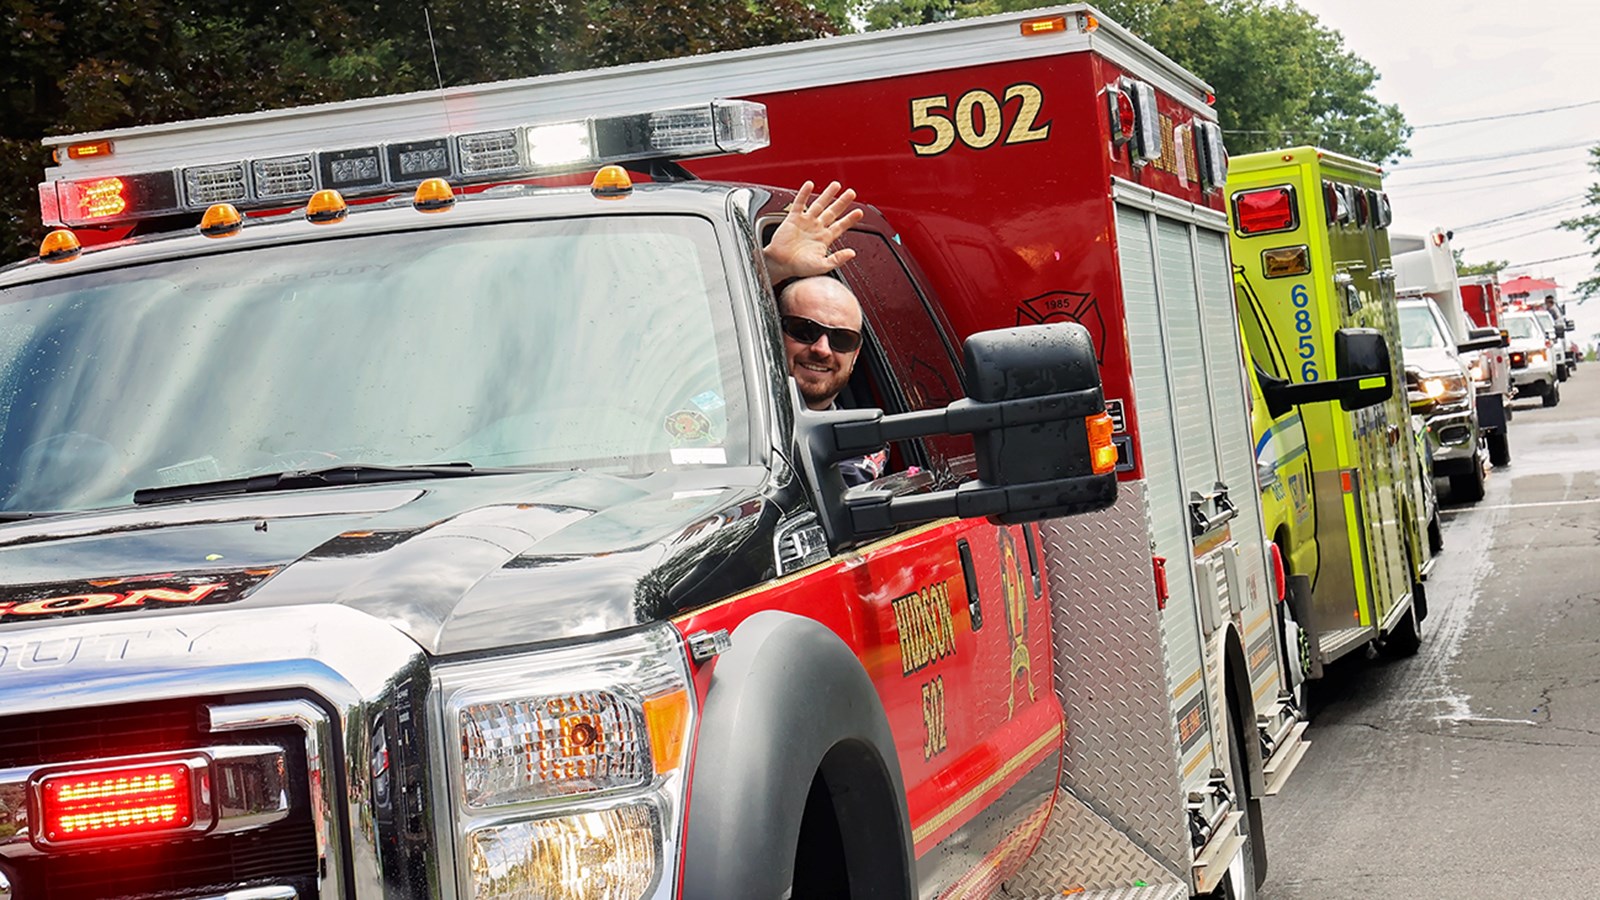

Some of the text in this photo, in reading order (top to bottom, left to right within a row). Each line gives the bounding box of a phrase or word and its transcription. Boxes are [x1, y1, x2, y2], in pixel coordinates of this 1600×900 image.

[908, 82, 1052, 157] 502
[309, 263, 392, 279] DUTY
[1044, 299, 1070, 310] 1985
[1291, 284, 1319, 383] 6856
[0, 582, 229, 616] ON
[891, 581, 956, 677] HUDSON
[922, 675, 947, 762] 502
